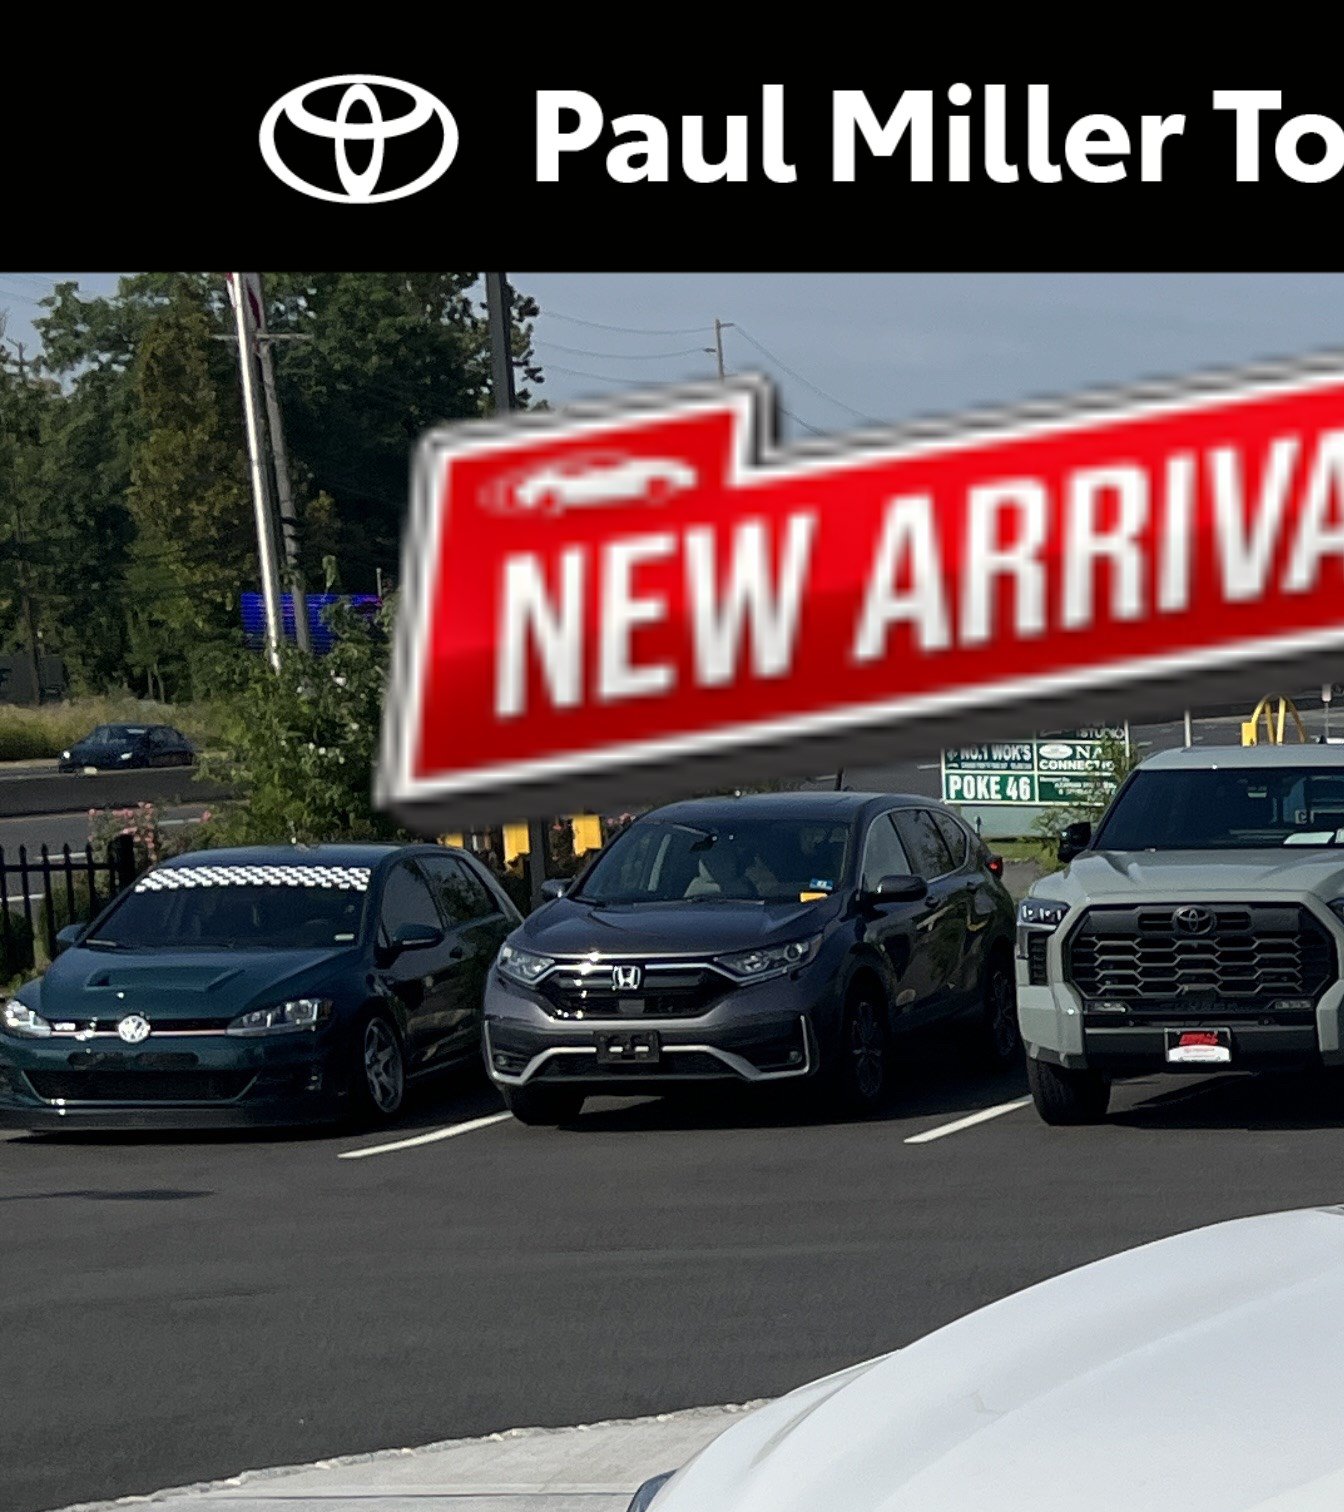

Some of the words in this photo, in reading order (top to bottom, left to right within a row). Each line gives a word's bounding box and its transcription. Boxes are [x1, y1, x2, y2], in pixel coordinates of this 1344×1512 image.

[960, 744, 988, 761] NO.1
[991, 744, 1032, 761] WOK'S
[949, 775, 1001, 800] POKE
[1006, 776, 1031, 800] 46
